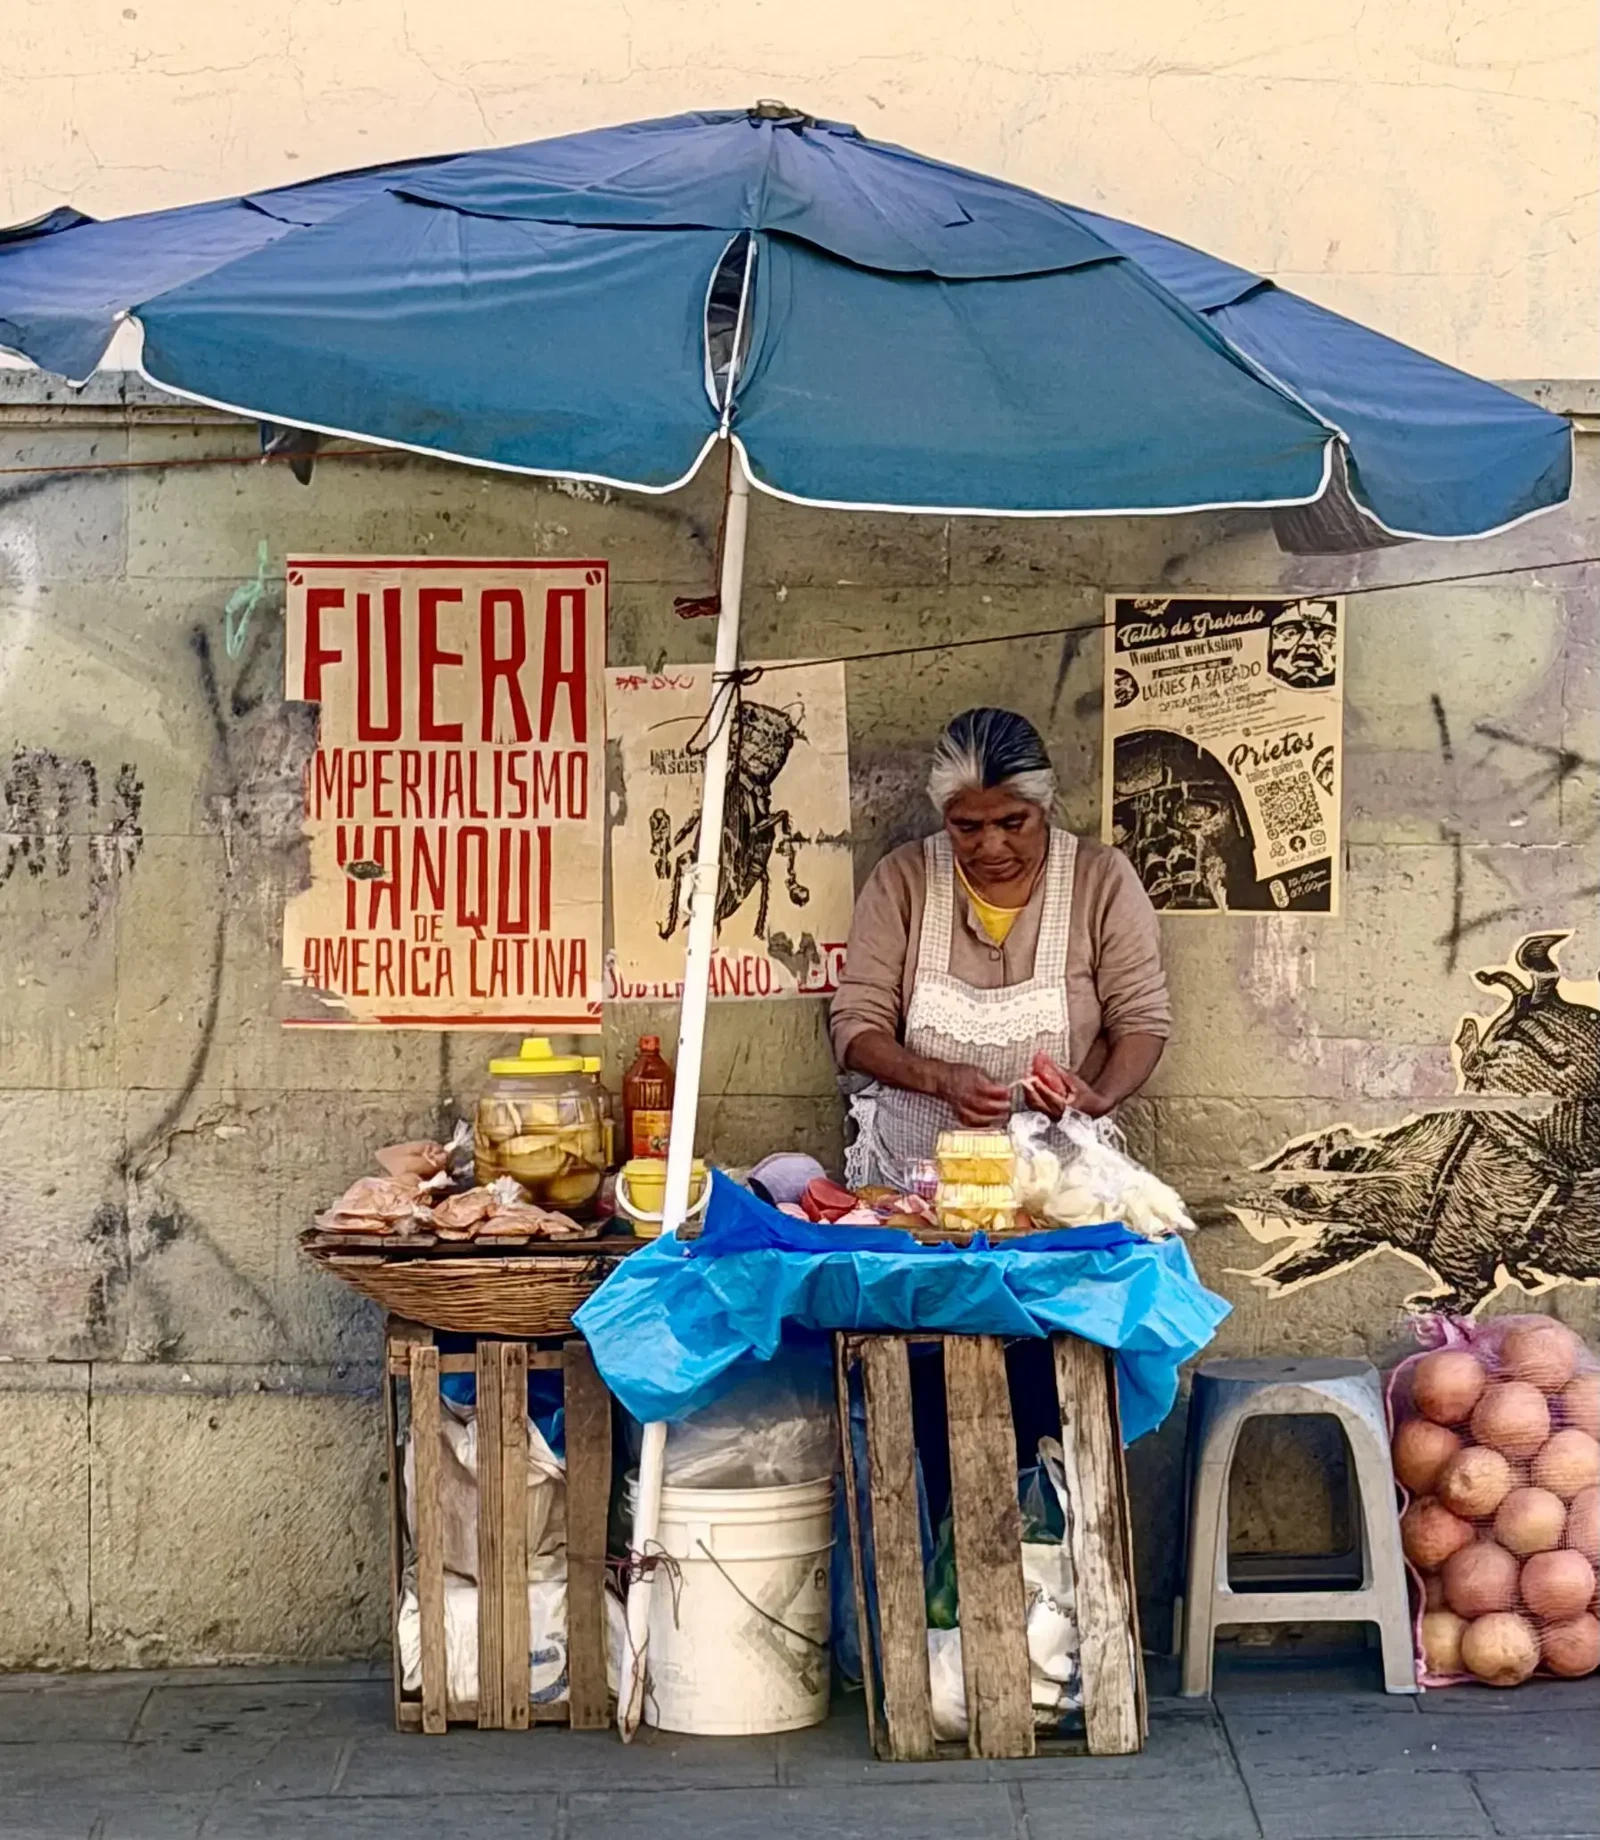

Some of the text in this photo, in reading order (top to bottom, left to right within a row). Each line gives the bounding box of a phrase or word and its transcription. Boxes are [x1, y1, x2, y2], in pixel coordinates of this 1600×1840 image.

[1117, 605, 1266, 648] Taller de Grabado
[1183, 636, 1244, 657] workshop
[303, 588, 588, 743] FUERA
[1141, 676, 1187, 702] LUNES
[1190, 674, 1201, 690] A
[1227, 732, 1314, 776] Prietos
[336, 825, 552, 940] YANQUI
[414, 914, 444, 943] DE
[303, 936, 587, 998] AMERICA LATINA
